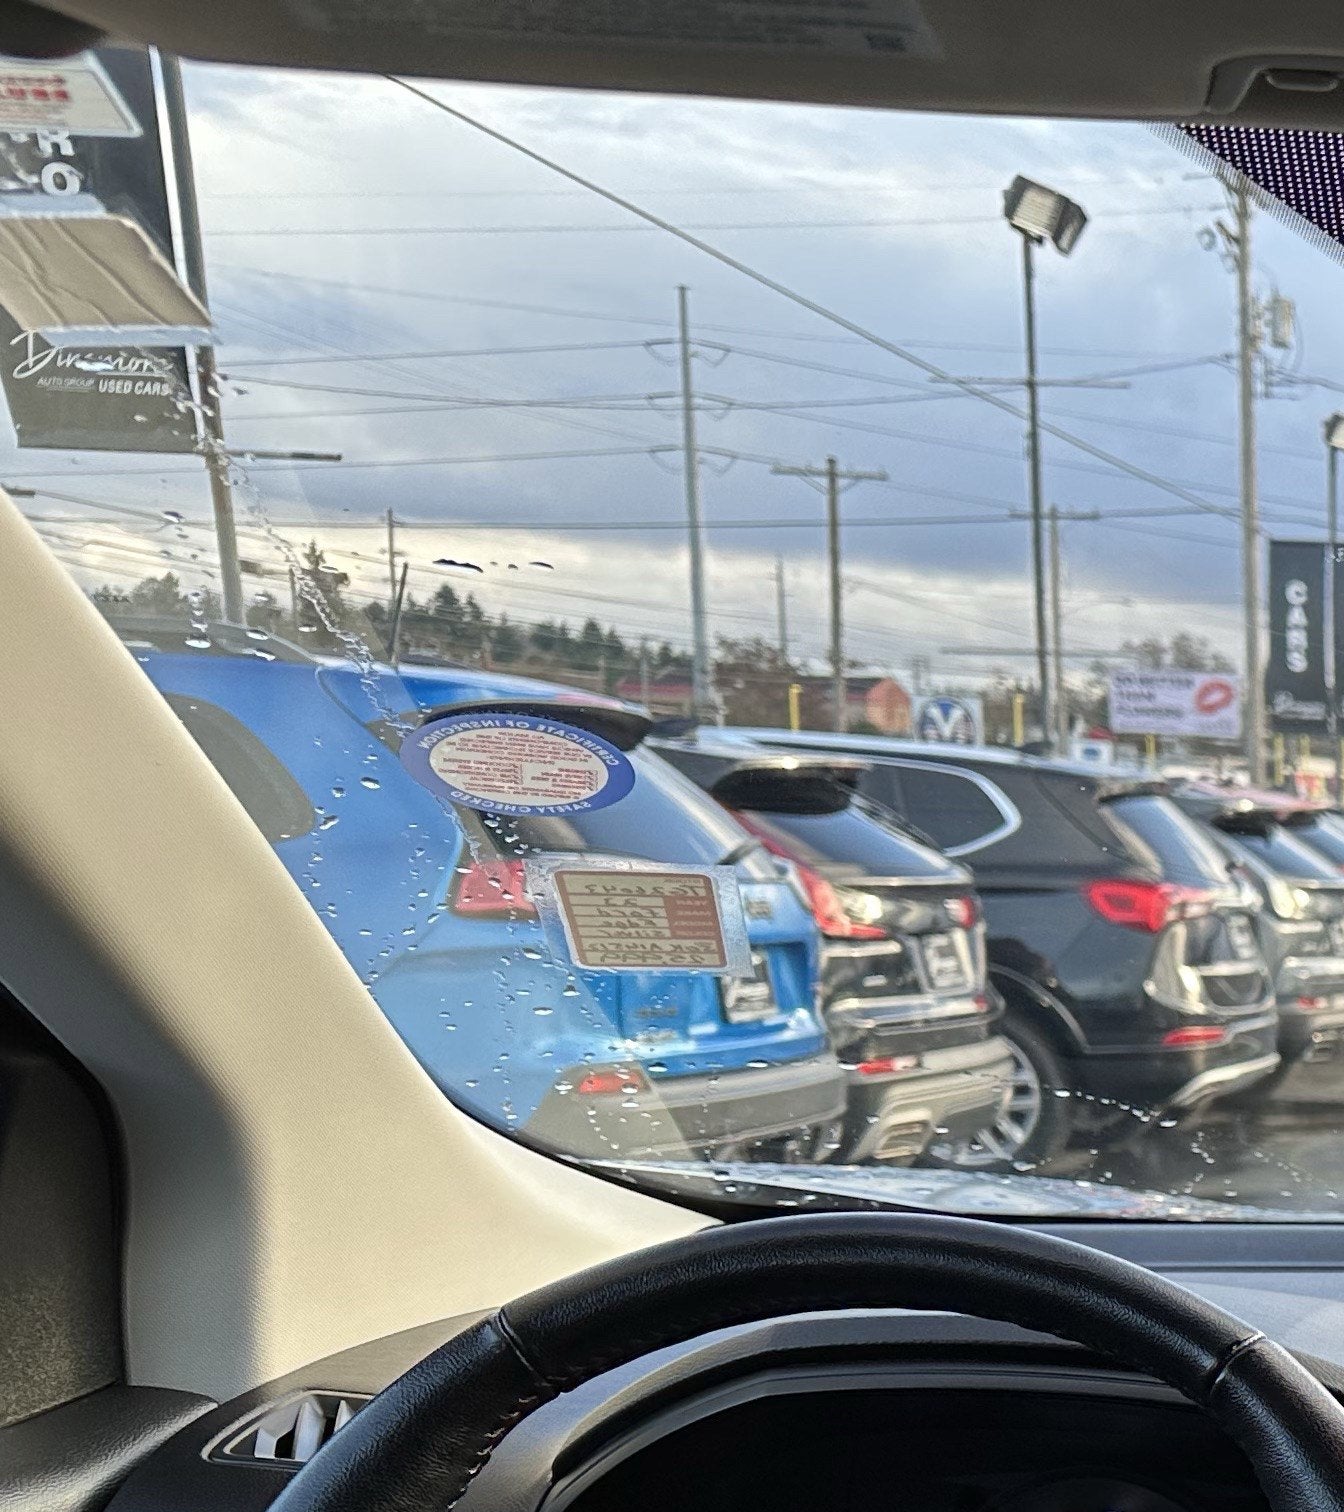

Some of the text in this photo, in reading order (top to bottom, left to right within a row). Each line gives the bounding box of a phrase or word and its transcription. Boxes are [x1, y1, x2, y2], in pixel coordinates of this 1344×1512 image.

[99, 379, 132, 394] USED
[134, 380, 173, 397] CARS
[1284, 578, 1309, 673] CARS
